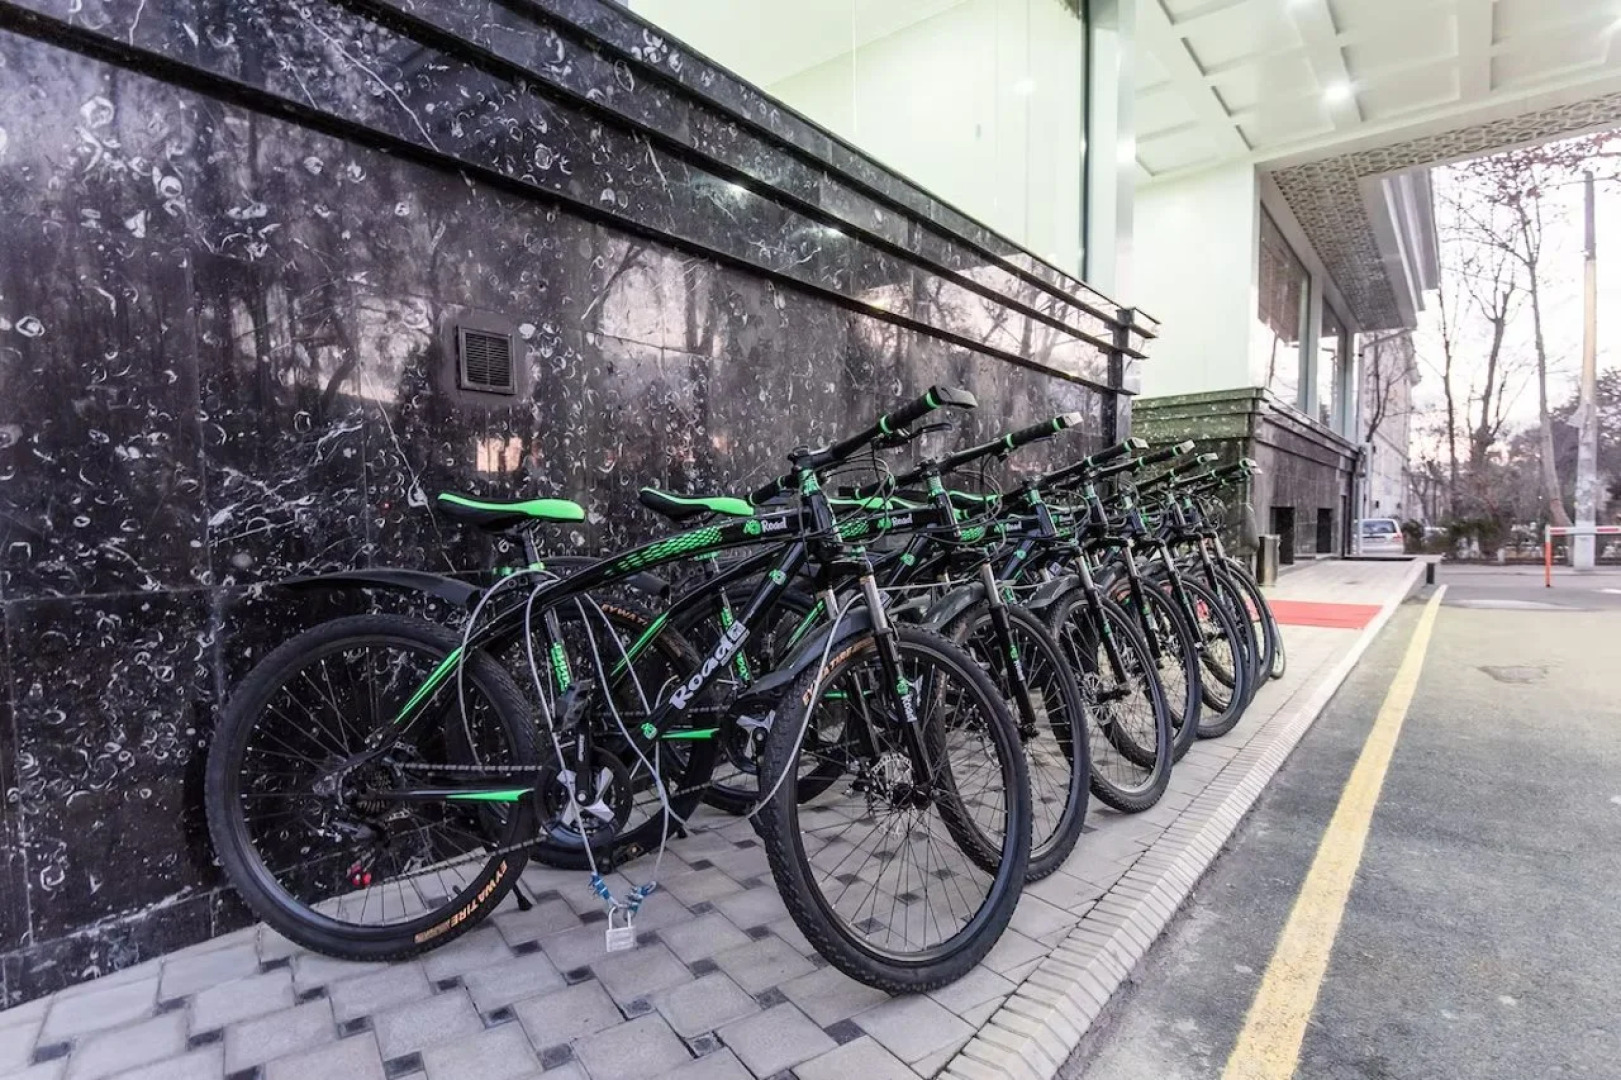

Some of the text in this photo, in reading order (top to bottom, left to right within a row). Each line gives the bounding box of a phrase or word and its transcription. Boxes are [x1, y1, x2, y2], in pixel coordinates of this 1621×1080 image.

[761, 516, 787, 532] Road
[669, 633, 733, 710] Road
[901, 691, 918, 723] Road
